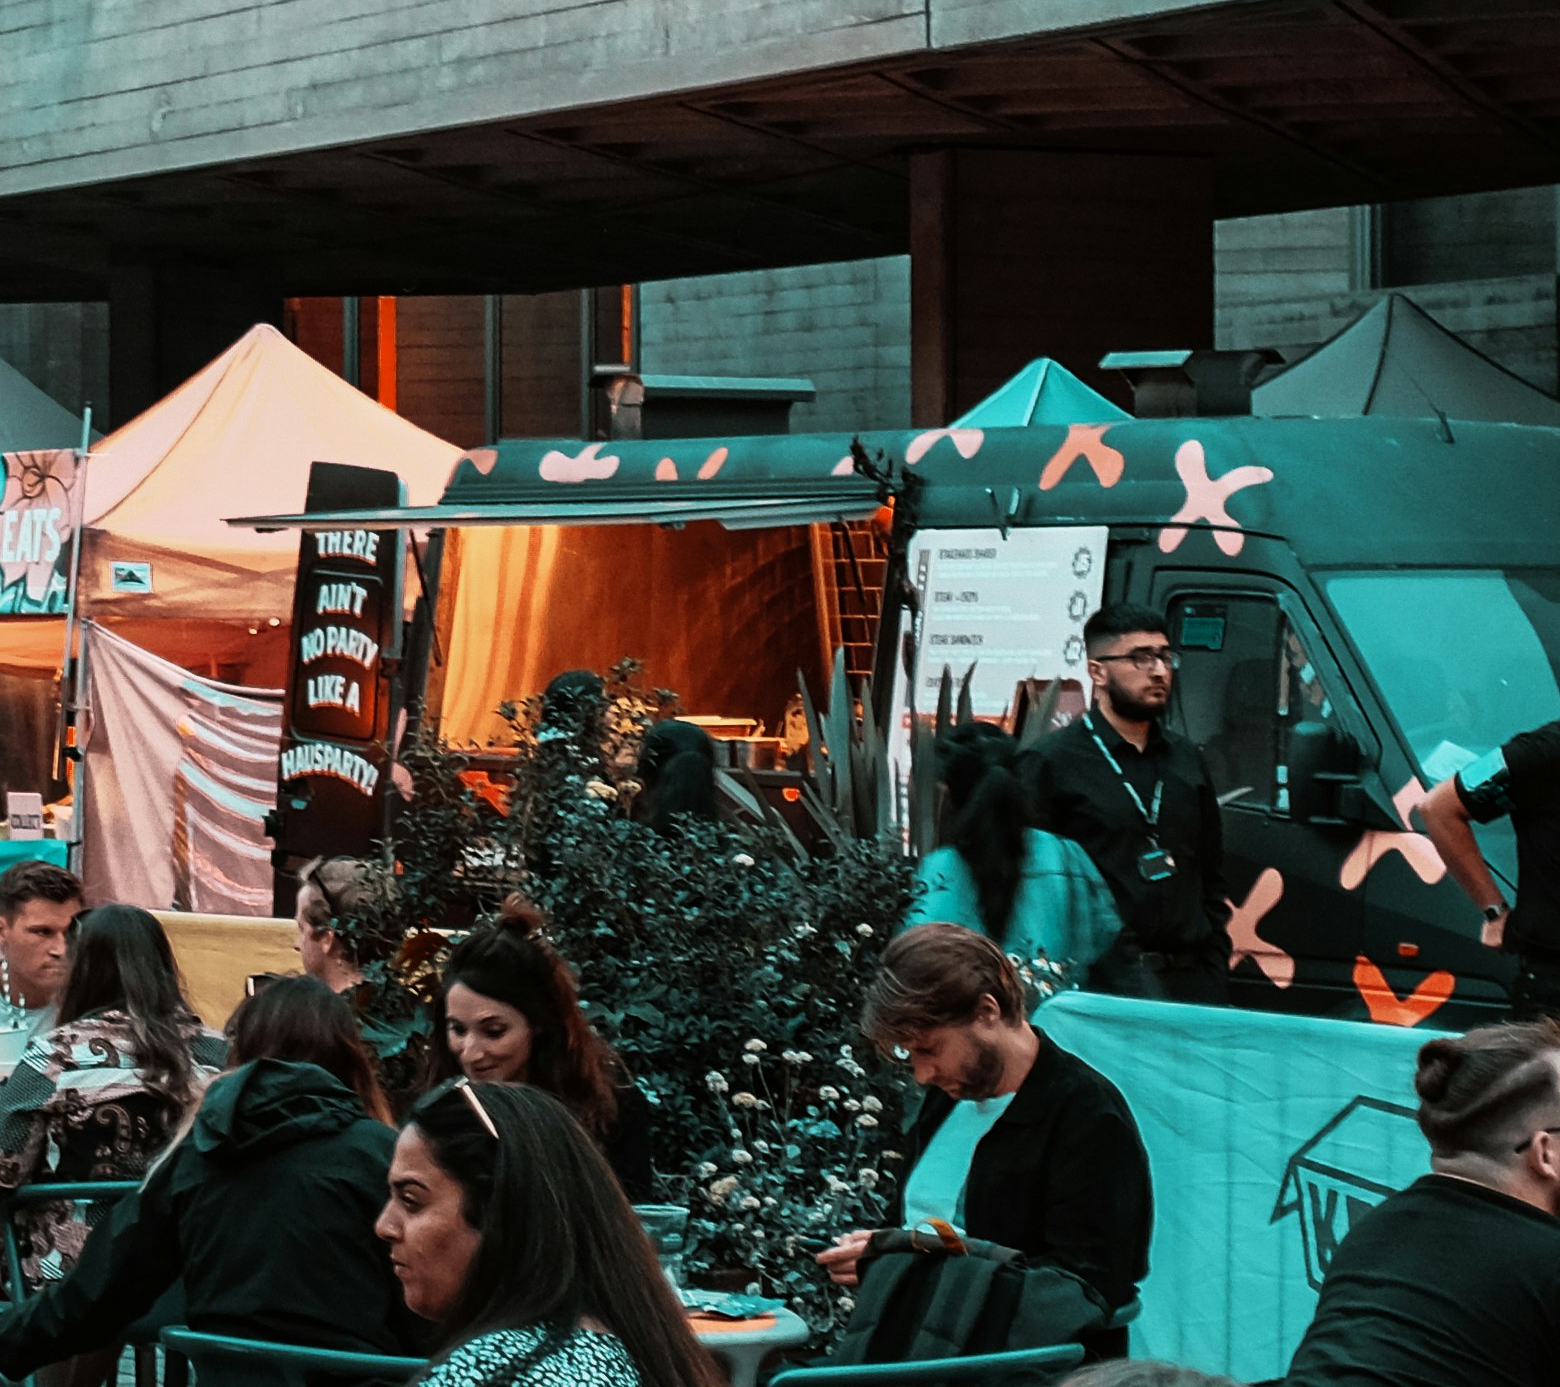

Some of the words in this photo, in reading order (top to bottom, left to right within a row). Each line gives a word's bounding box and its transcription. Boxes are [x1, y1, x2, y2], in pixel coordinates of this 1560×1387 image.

[1, 507, 62, 563] EATS
[314, 529, 380, 567] THERE
[316, 582, 367, 619] AIN'T
[300, 627, 326, 665] NO
[326, 626, 380, 671] PARTY
[307, 675, 346, 710] LIKE
[345, 681, 361, 718] A
